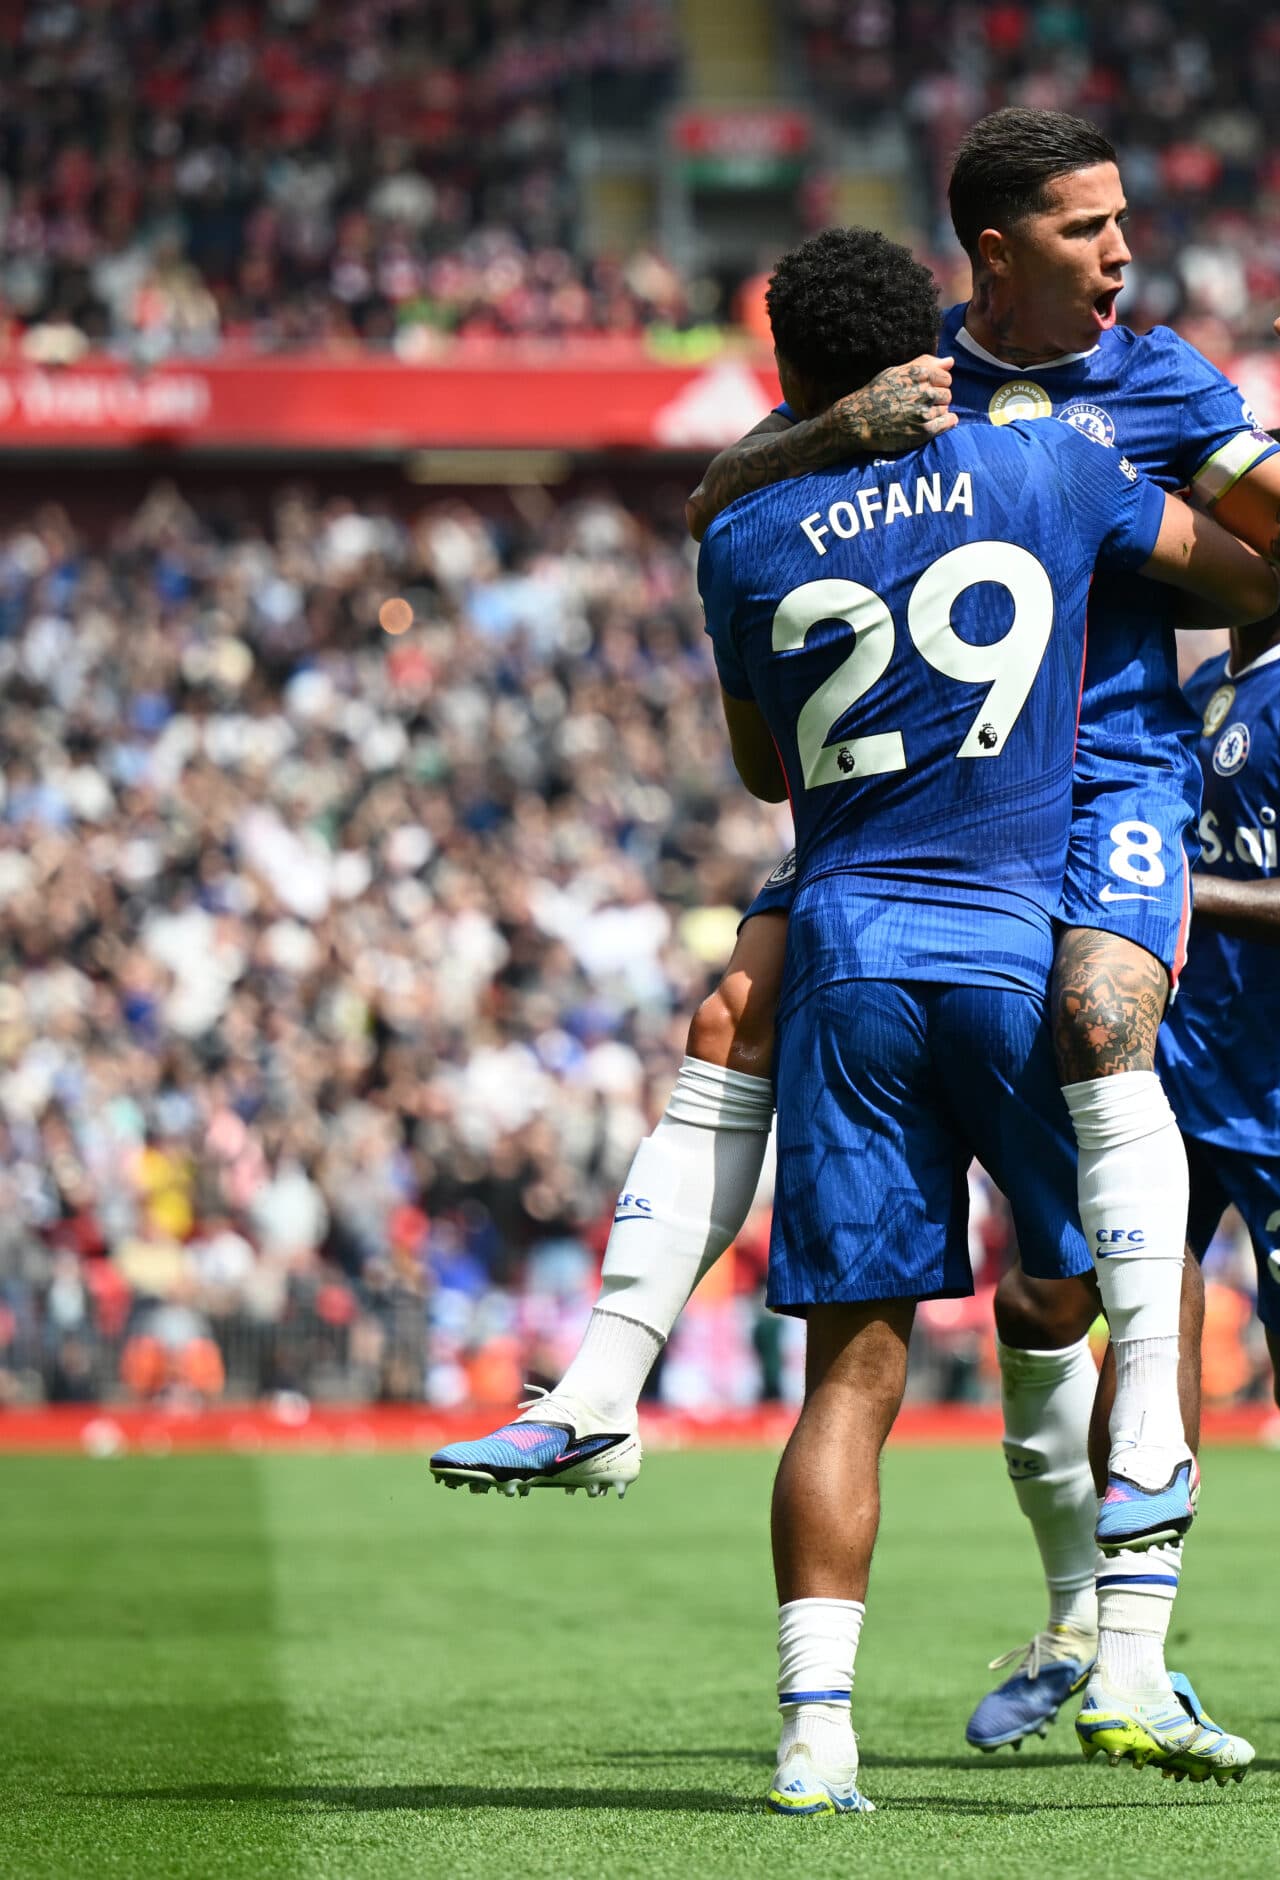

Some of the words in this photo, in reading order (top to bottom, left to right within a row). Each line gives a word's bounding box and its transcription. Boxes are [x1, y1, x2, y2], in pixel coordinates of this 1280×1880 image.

[1067, 405, 1105, 421] CHELSEA
[799, 472, 974, 556] FOFANA
[771, 540, 1054, 791] 29
[1108, 820, 1166, 887] 8
[1096, 1229, 1145, 1242] CFC
